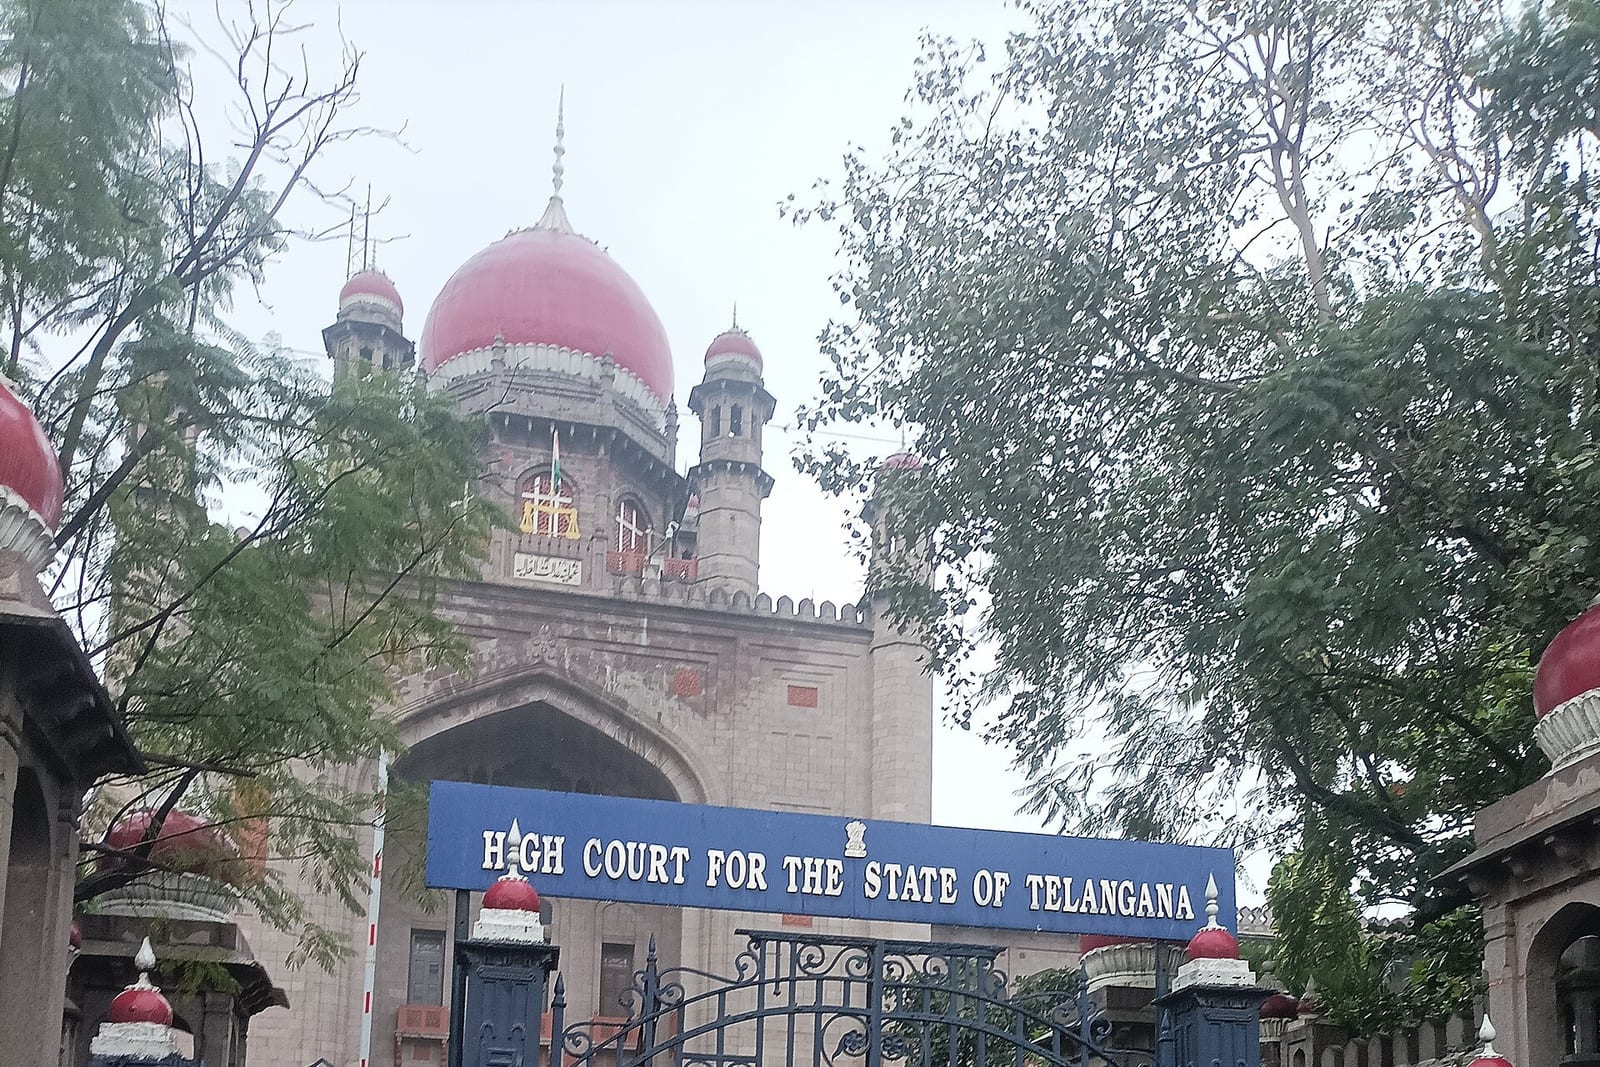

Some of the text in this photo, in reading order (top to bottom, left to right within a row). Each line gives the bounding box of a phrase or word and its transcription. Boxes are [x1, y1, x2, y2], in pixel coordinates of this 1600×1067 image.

[482, 830, 1195, 920] HGH COURT FOR THE STATE OF TELANGANA
